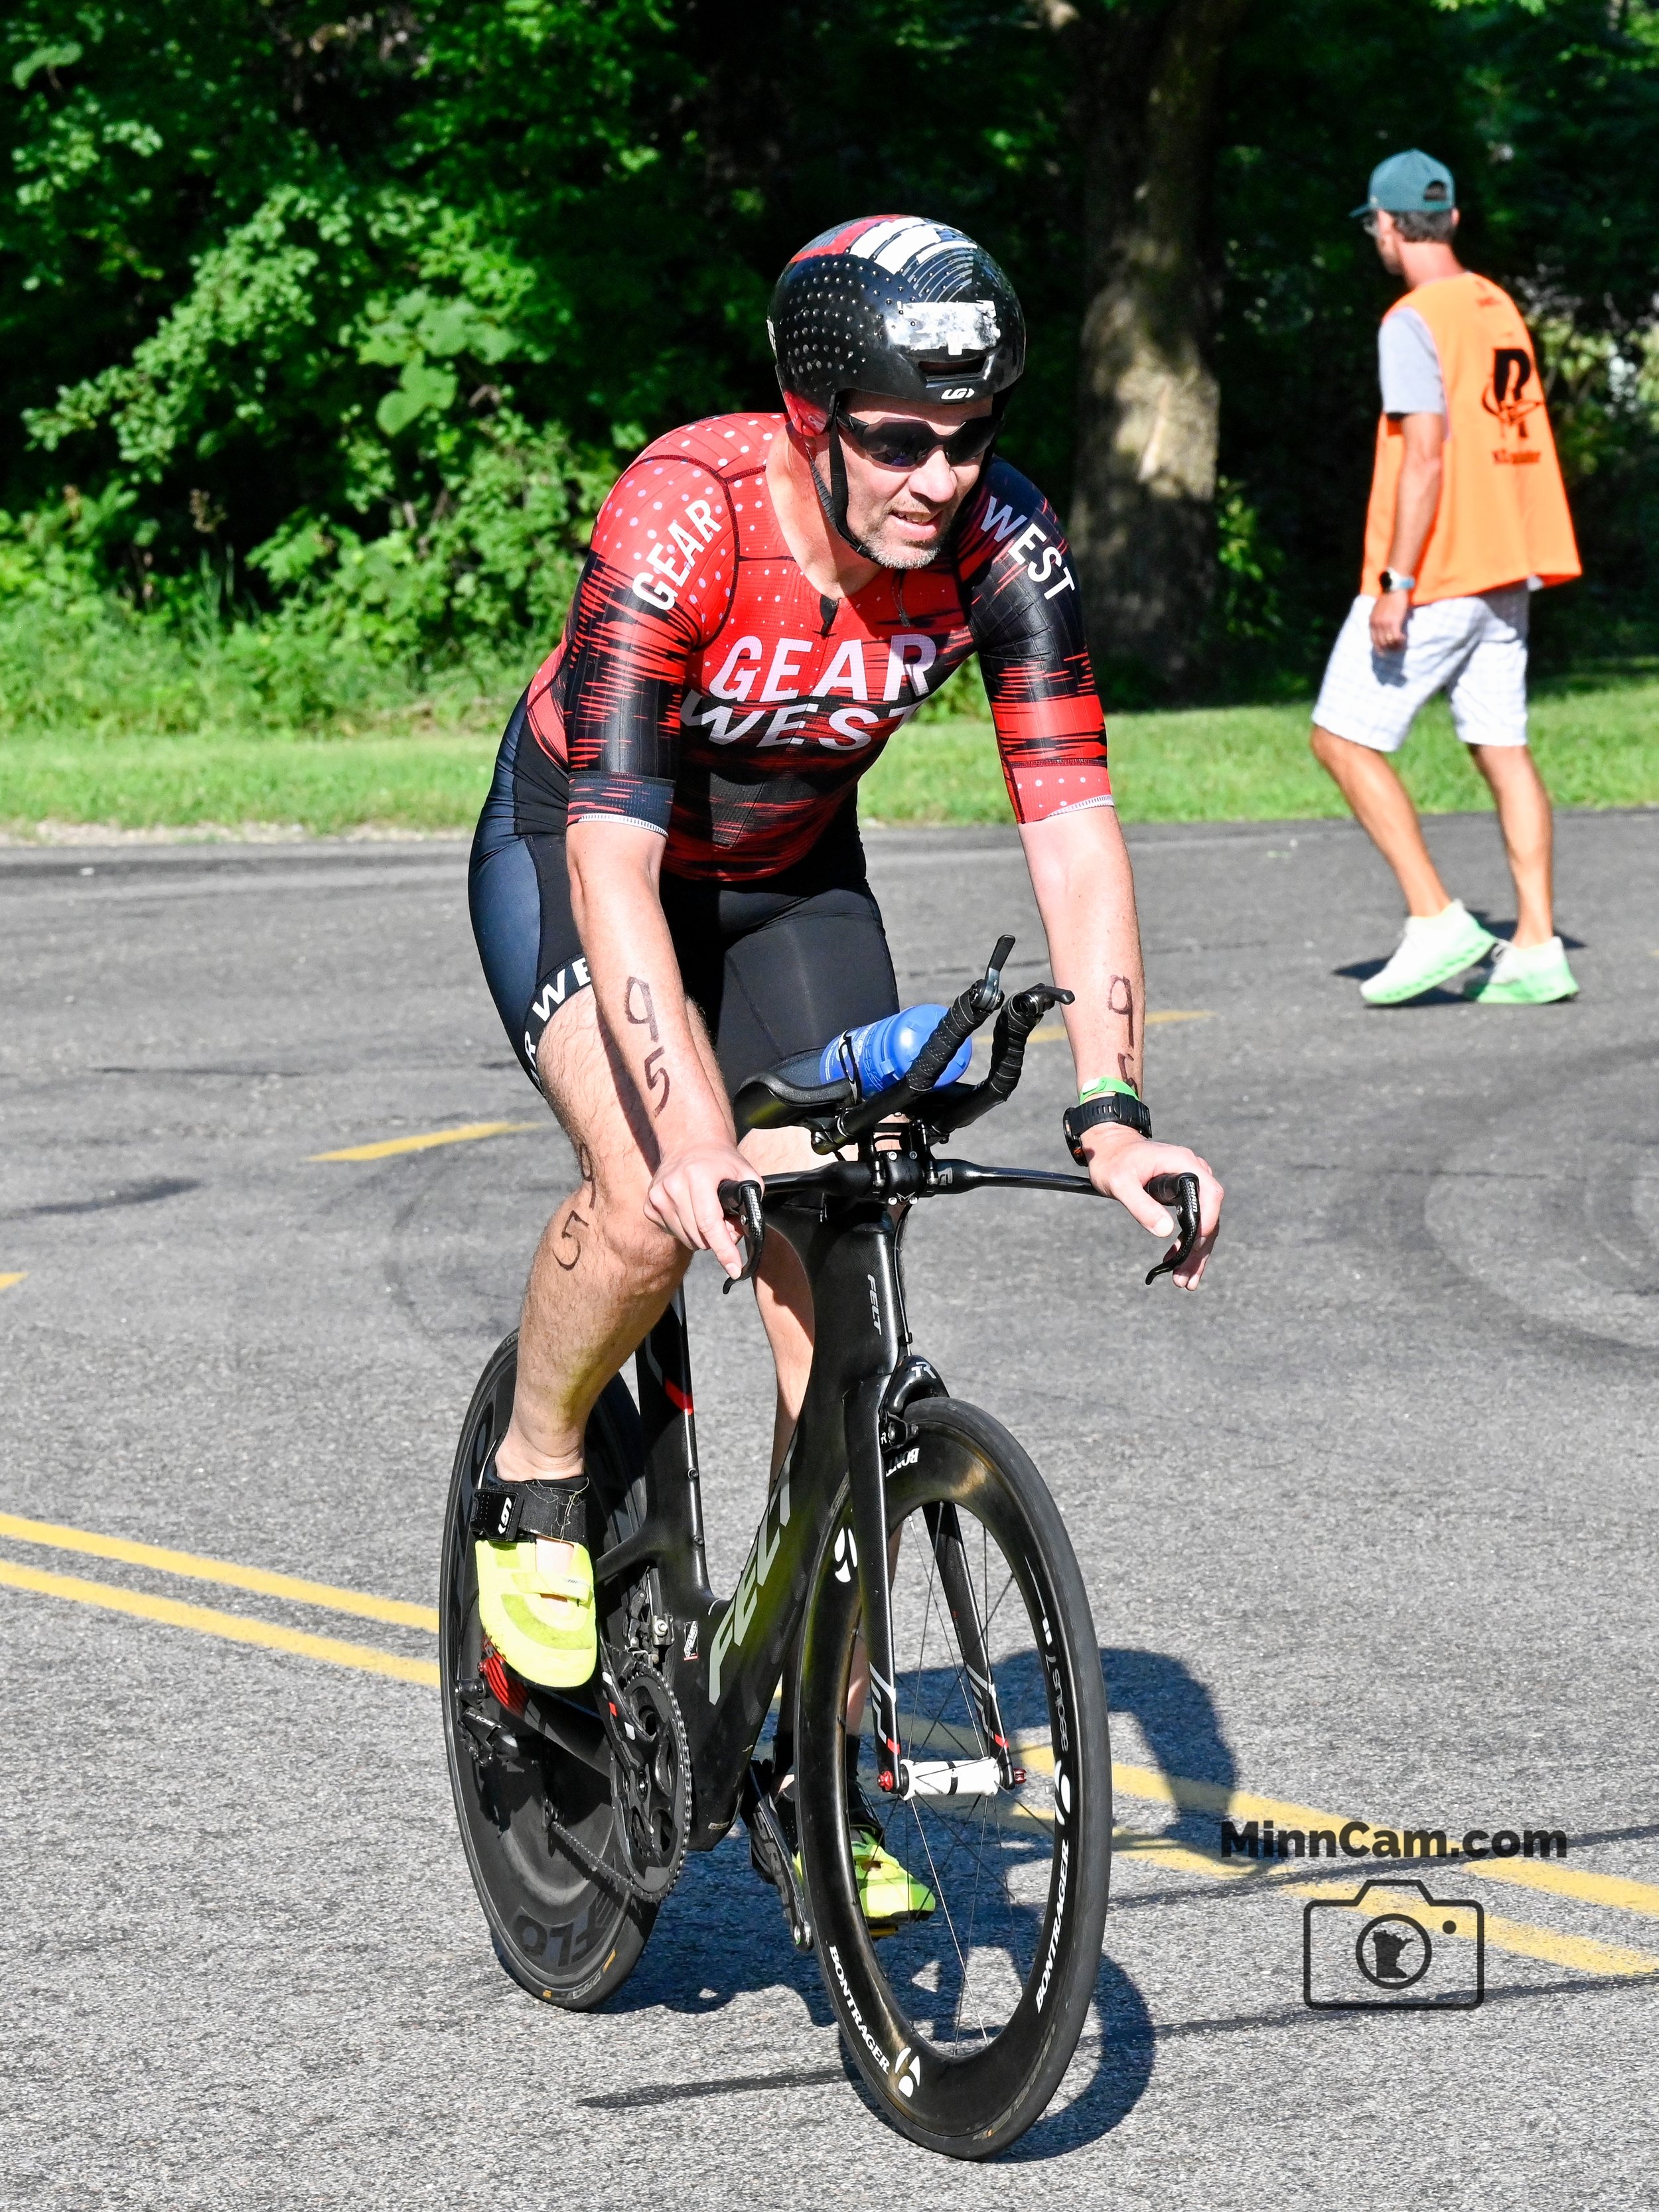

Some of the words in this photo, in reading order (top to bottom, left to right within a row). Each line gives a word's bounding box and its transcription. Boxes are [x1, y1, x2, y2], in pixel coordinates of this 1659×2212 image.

[632, 499, 722, 610] GEAR
[979, 496, 1076, 600] WEST
[708, 634, 938, 703] GEAR
[680, 689, 924, 750] WEST
[532, 957, 591, 1022] WE
[749, 1188, 762, 1221] SRAM
[1188, 1181, 1198, 1213] SRAM
[867, 1274, 882, 1336] FELT
[709, 1428, 798, 1705] FELT
[1037, 1838, 1070, 2014] BONTRAGER
[828, 1945, 891, 2075] BONTRAGER
